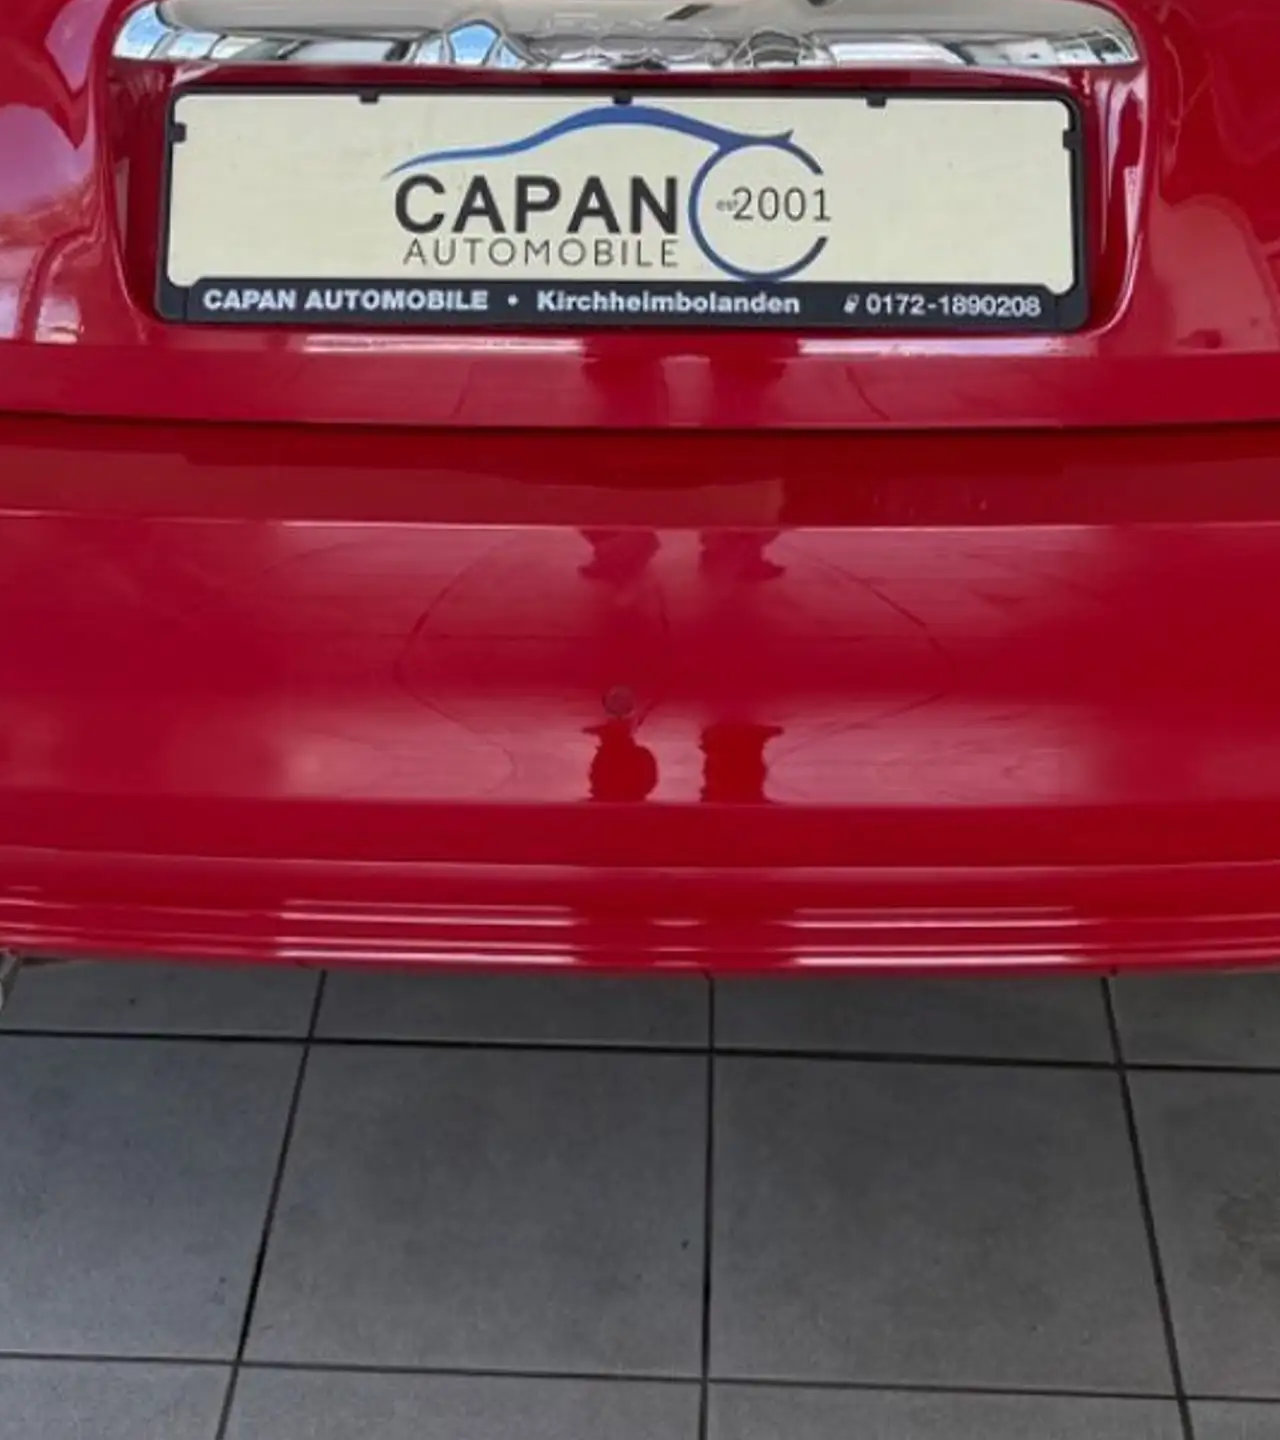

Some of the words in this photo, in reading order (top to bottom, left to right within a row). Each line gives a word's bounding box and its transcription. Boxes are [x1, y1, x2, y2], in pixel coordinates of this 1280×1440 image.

[394, 174, 679, 234] CAPAN
[731, 186, 832, 222] 2001
[403, 237, 680, 267] AUTOMOBILE
[202, 289, 297, 311] CAPAN
[304, 290, 489, 311] AUTOMOBILE
[536, 290, 801, 314] Kirchheimbolanden
[866, 294, 1043, 317] 0172-1890208
